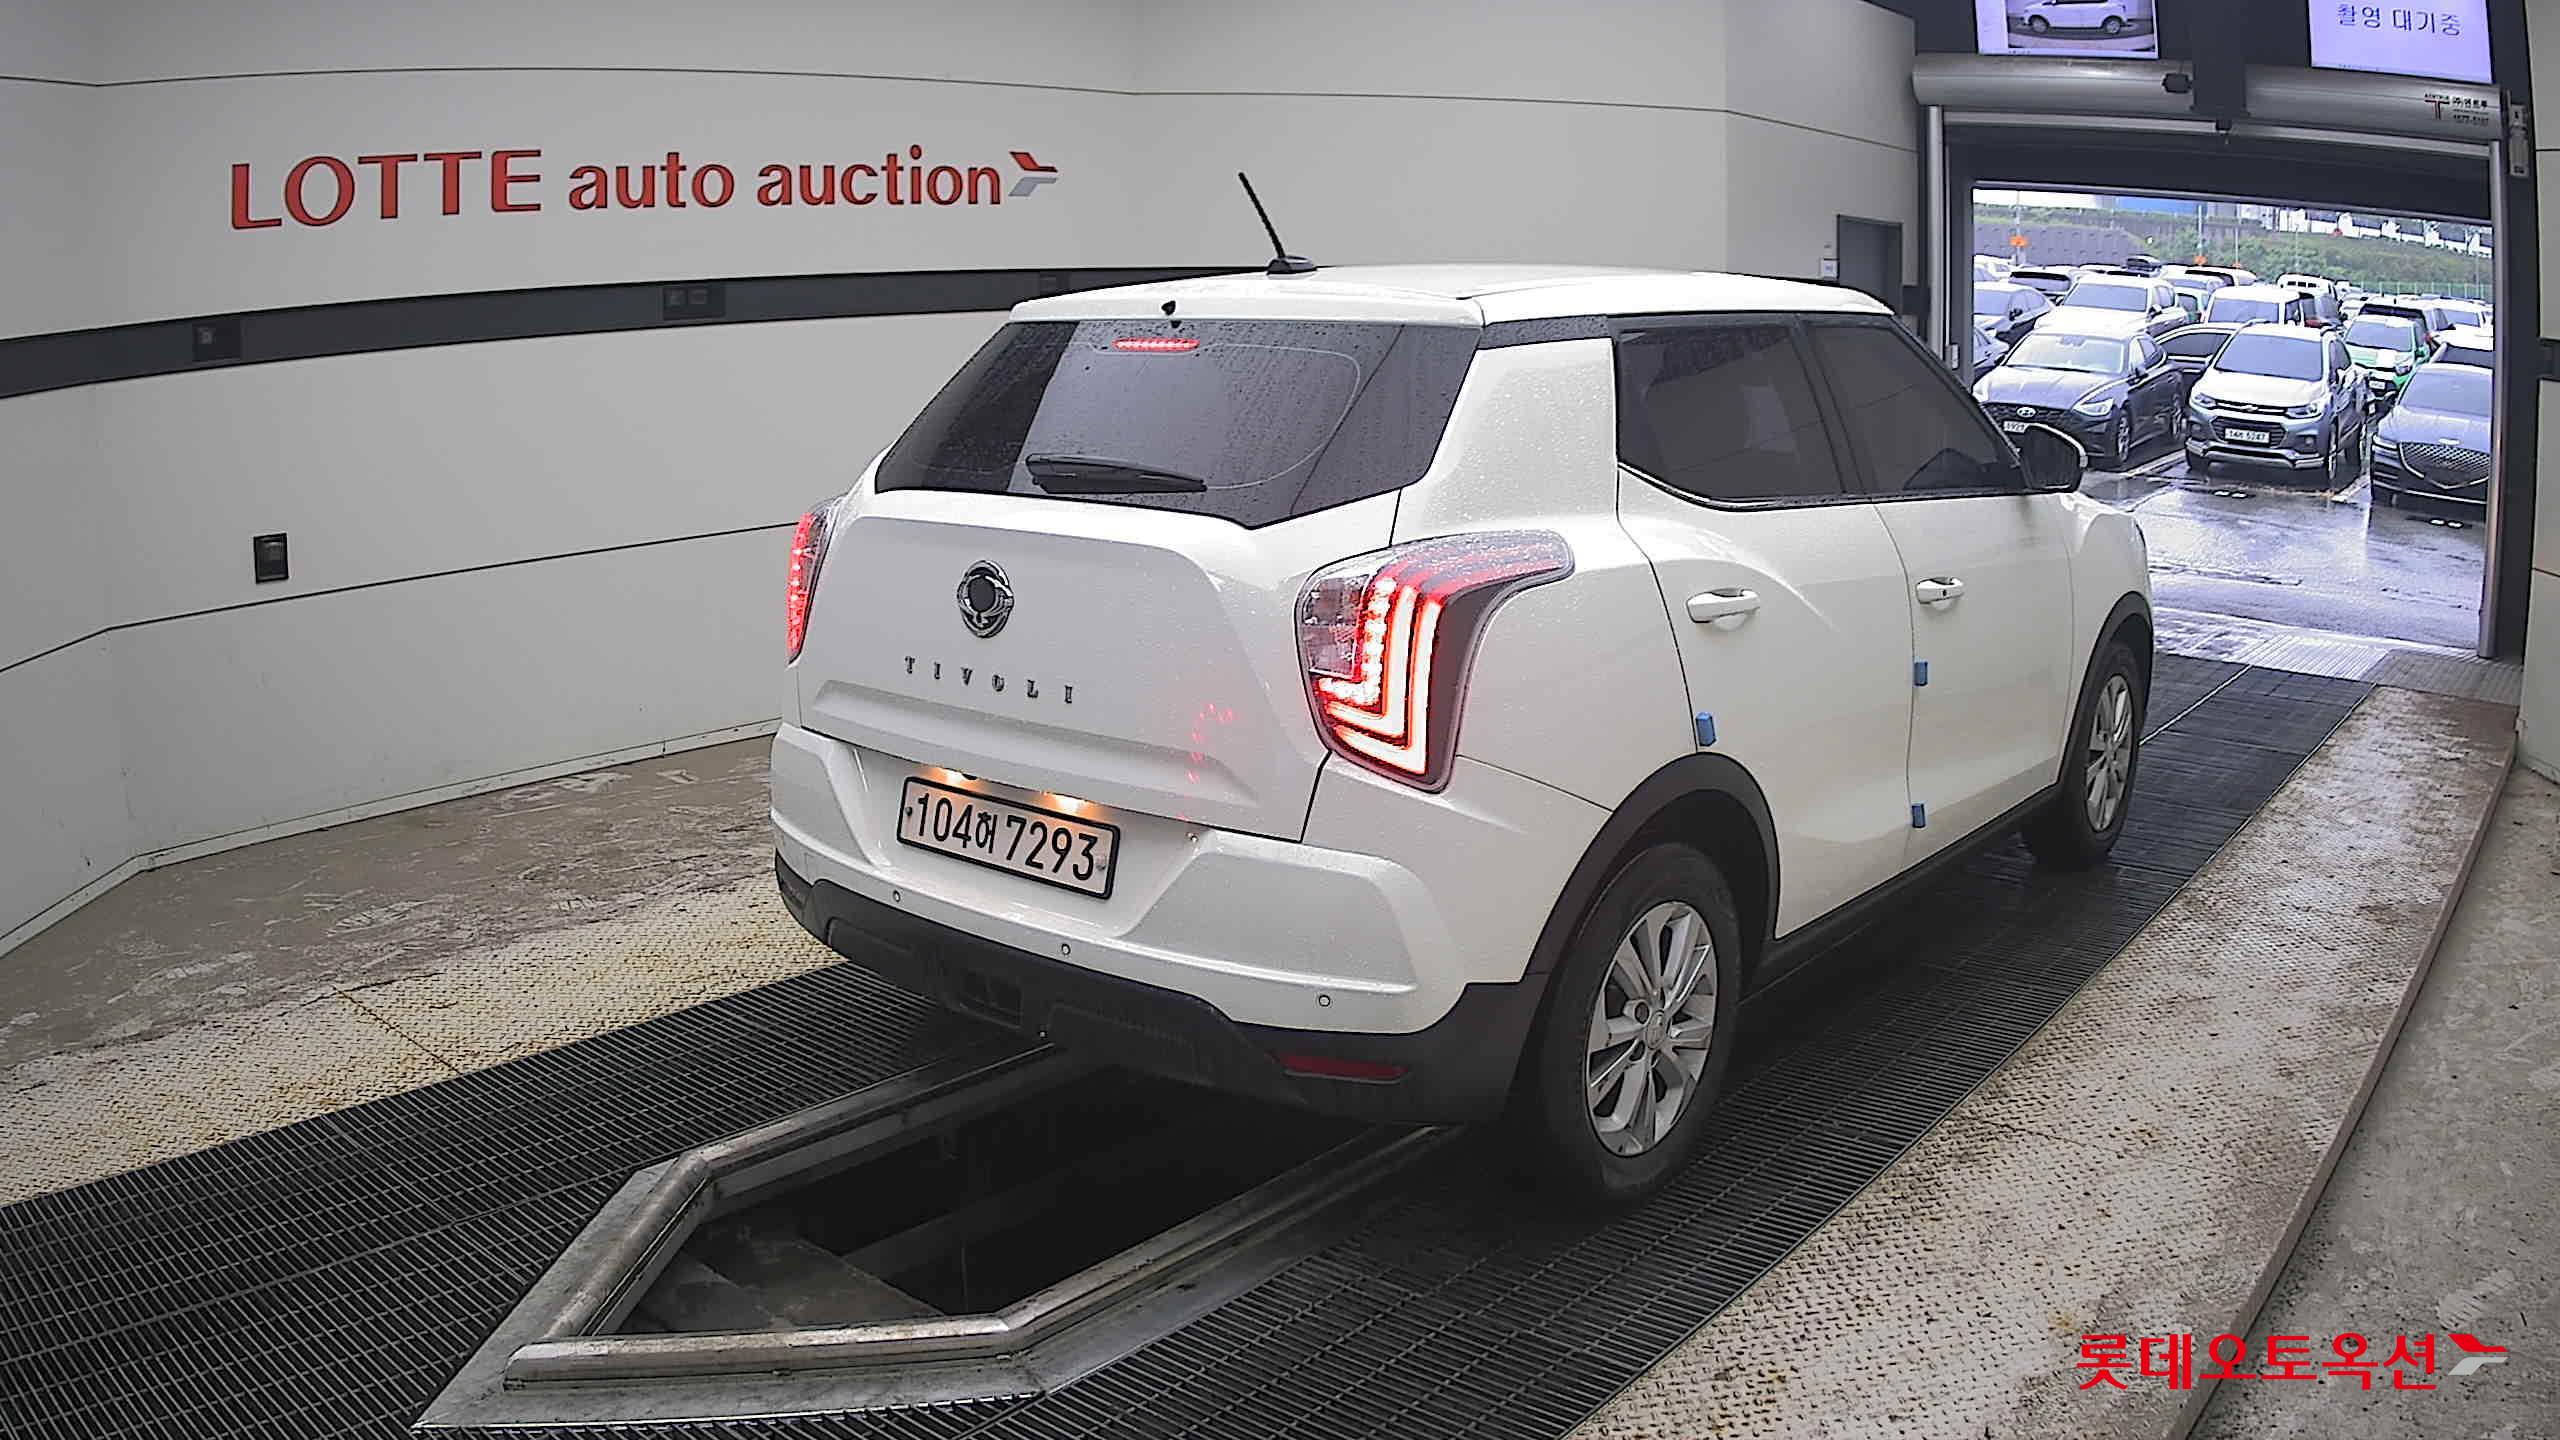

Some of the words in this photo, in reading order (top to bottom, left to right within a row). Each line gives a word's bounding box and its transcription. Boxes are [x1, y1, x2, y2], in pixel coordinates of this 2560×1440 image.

[2392, 9, 2461, 36] 대기중
[231, 147, 541, 229] LOTTE
[569, 151, 736, 210] auto
[756, 145, 1002, 206] auction
[904, 656, 1073, 704] TIVOLI
